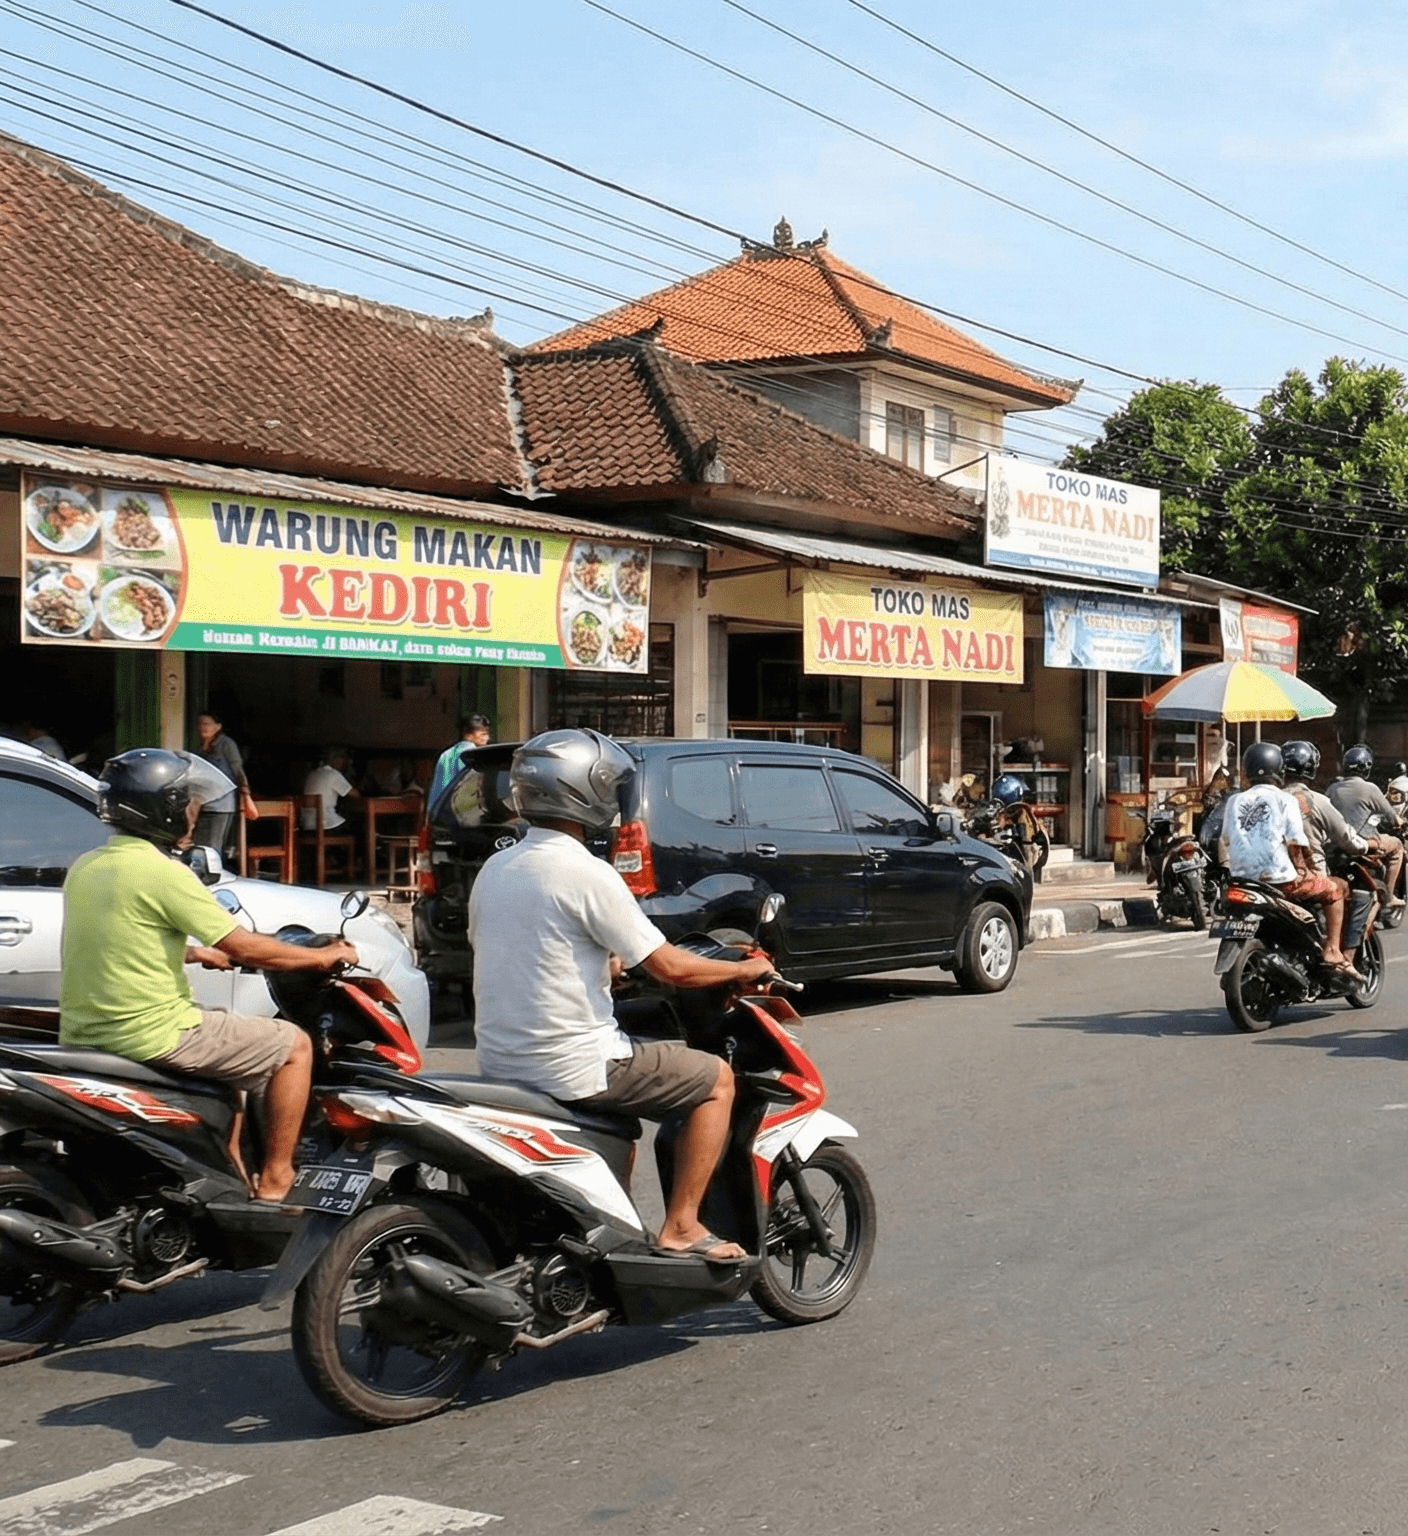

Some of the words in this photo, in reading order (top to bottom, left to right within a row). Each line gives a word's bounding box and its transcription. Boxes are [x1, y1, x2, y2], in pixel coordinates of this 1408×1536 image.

[1046, 472, 1091, 497] TOKO
[1096, 484, 1128, 505] MAS
[211, 501, 398, 561] WARUNG
[413, 525, 542, 575] MAKAN
[1016, 490, 1096, 532] MERTA
[1101, 507, 1155, 543] NADI
[278, 563, 493, 630] KEDIRI
[870, 587, 925, 615] TOKO
[931, 593, 970, 620] MAS
[816, 616, 935, 668] MERTA
[941, 628, 1015, 673] NADI
